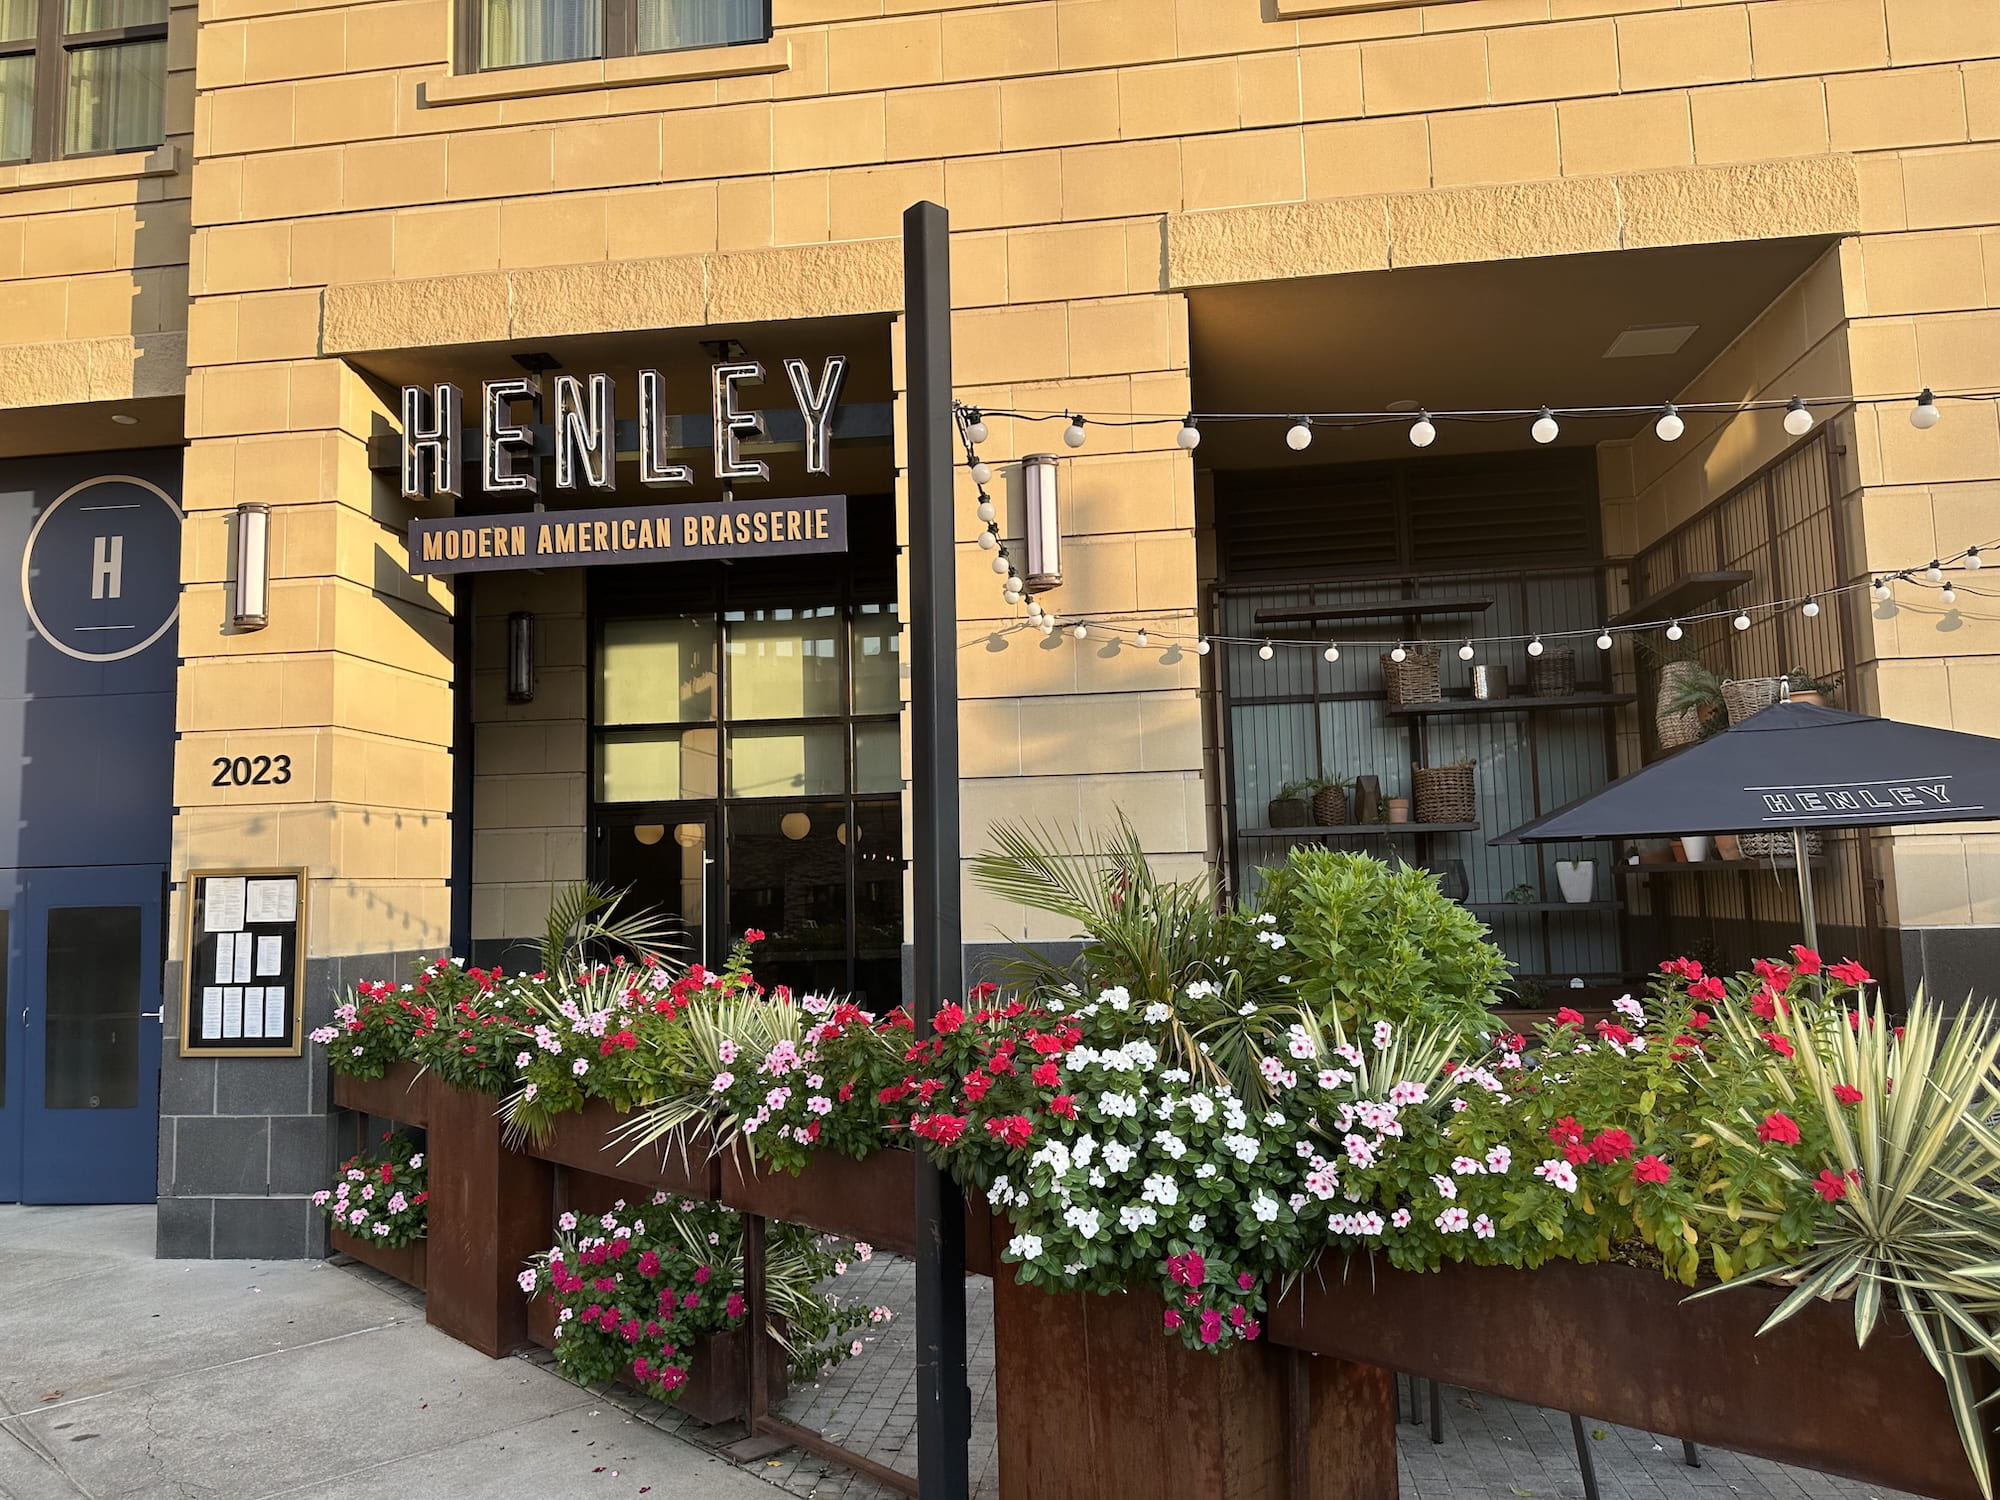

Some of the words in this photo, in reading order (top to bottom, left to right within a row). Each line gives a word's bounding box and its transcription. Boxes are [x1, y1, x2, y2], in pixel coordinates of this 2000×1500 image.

[401, 355, 847, 498] HENLEY
[422, 526, 525, 562] MODERN
[536, 517, 671, 554] AMERICAN
[683, 508, 829, 547] BRASSERIE
[91, 535, 123, 600] H
[212, 754, 291, 787] 2023
[1762, 784, 1951, 813] HENLEY
